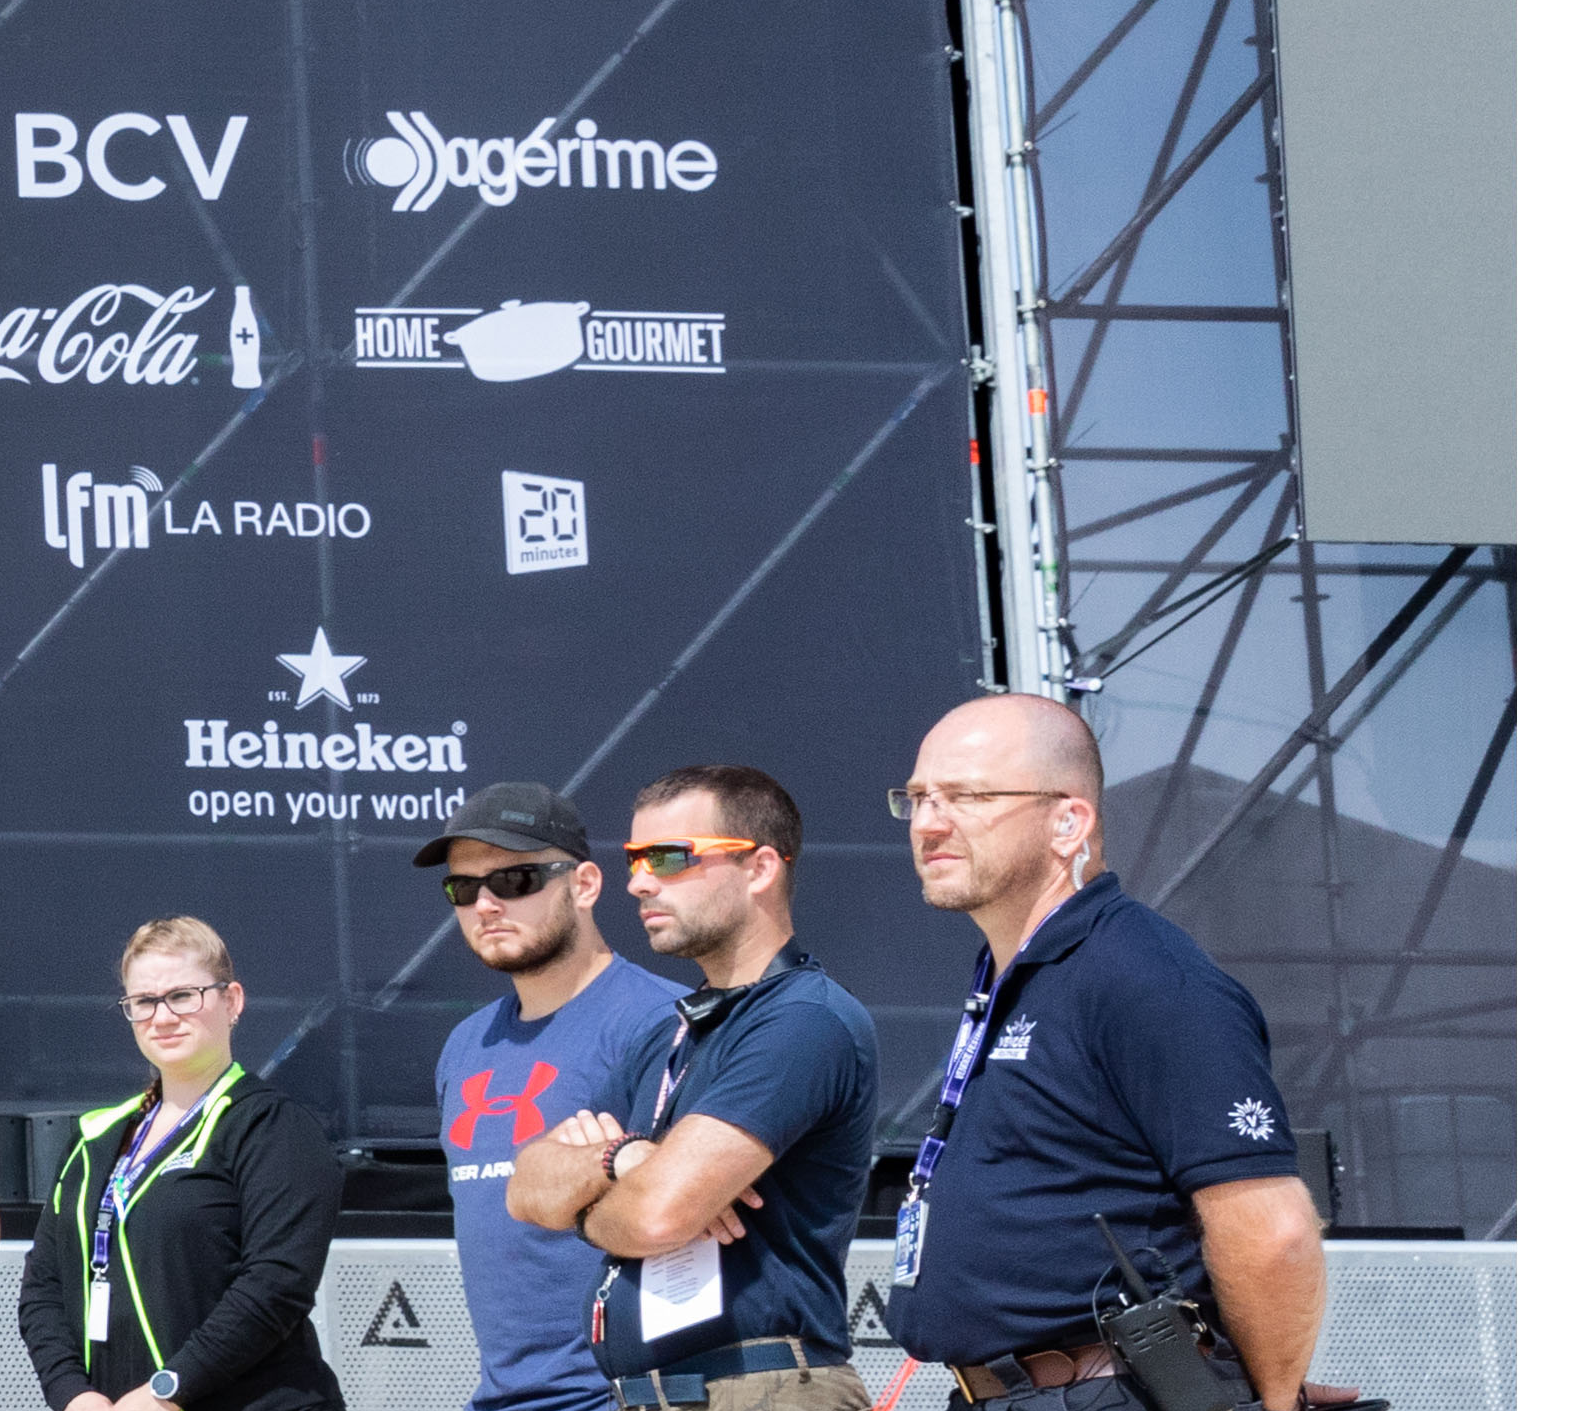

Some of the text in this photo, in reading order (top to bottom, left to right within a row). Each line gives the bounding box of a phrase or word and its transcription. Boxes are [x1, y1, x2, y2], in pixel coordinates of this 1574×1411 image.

[14, 113, 248, 201] BCV
[355, 318, 441, 359] HOME
[586, 320, 725, 364] GOURMET
[164, 500, 371, 540] LA RADIO
[519, 483, 577, 542] 20
[521, 547, 579, 563] minutes
[357, 693, 380, 704] 1873
[188, 790, 275, 823] open
[286, 792, 361, 824] your
[371, 787, 465, 821] world
